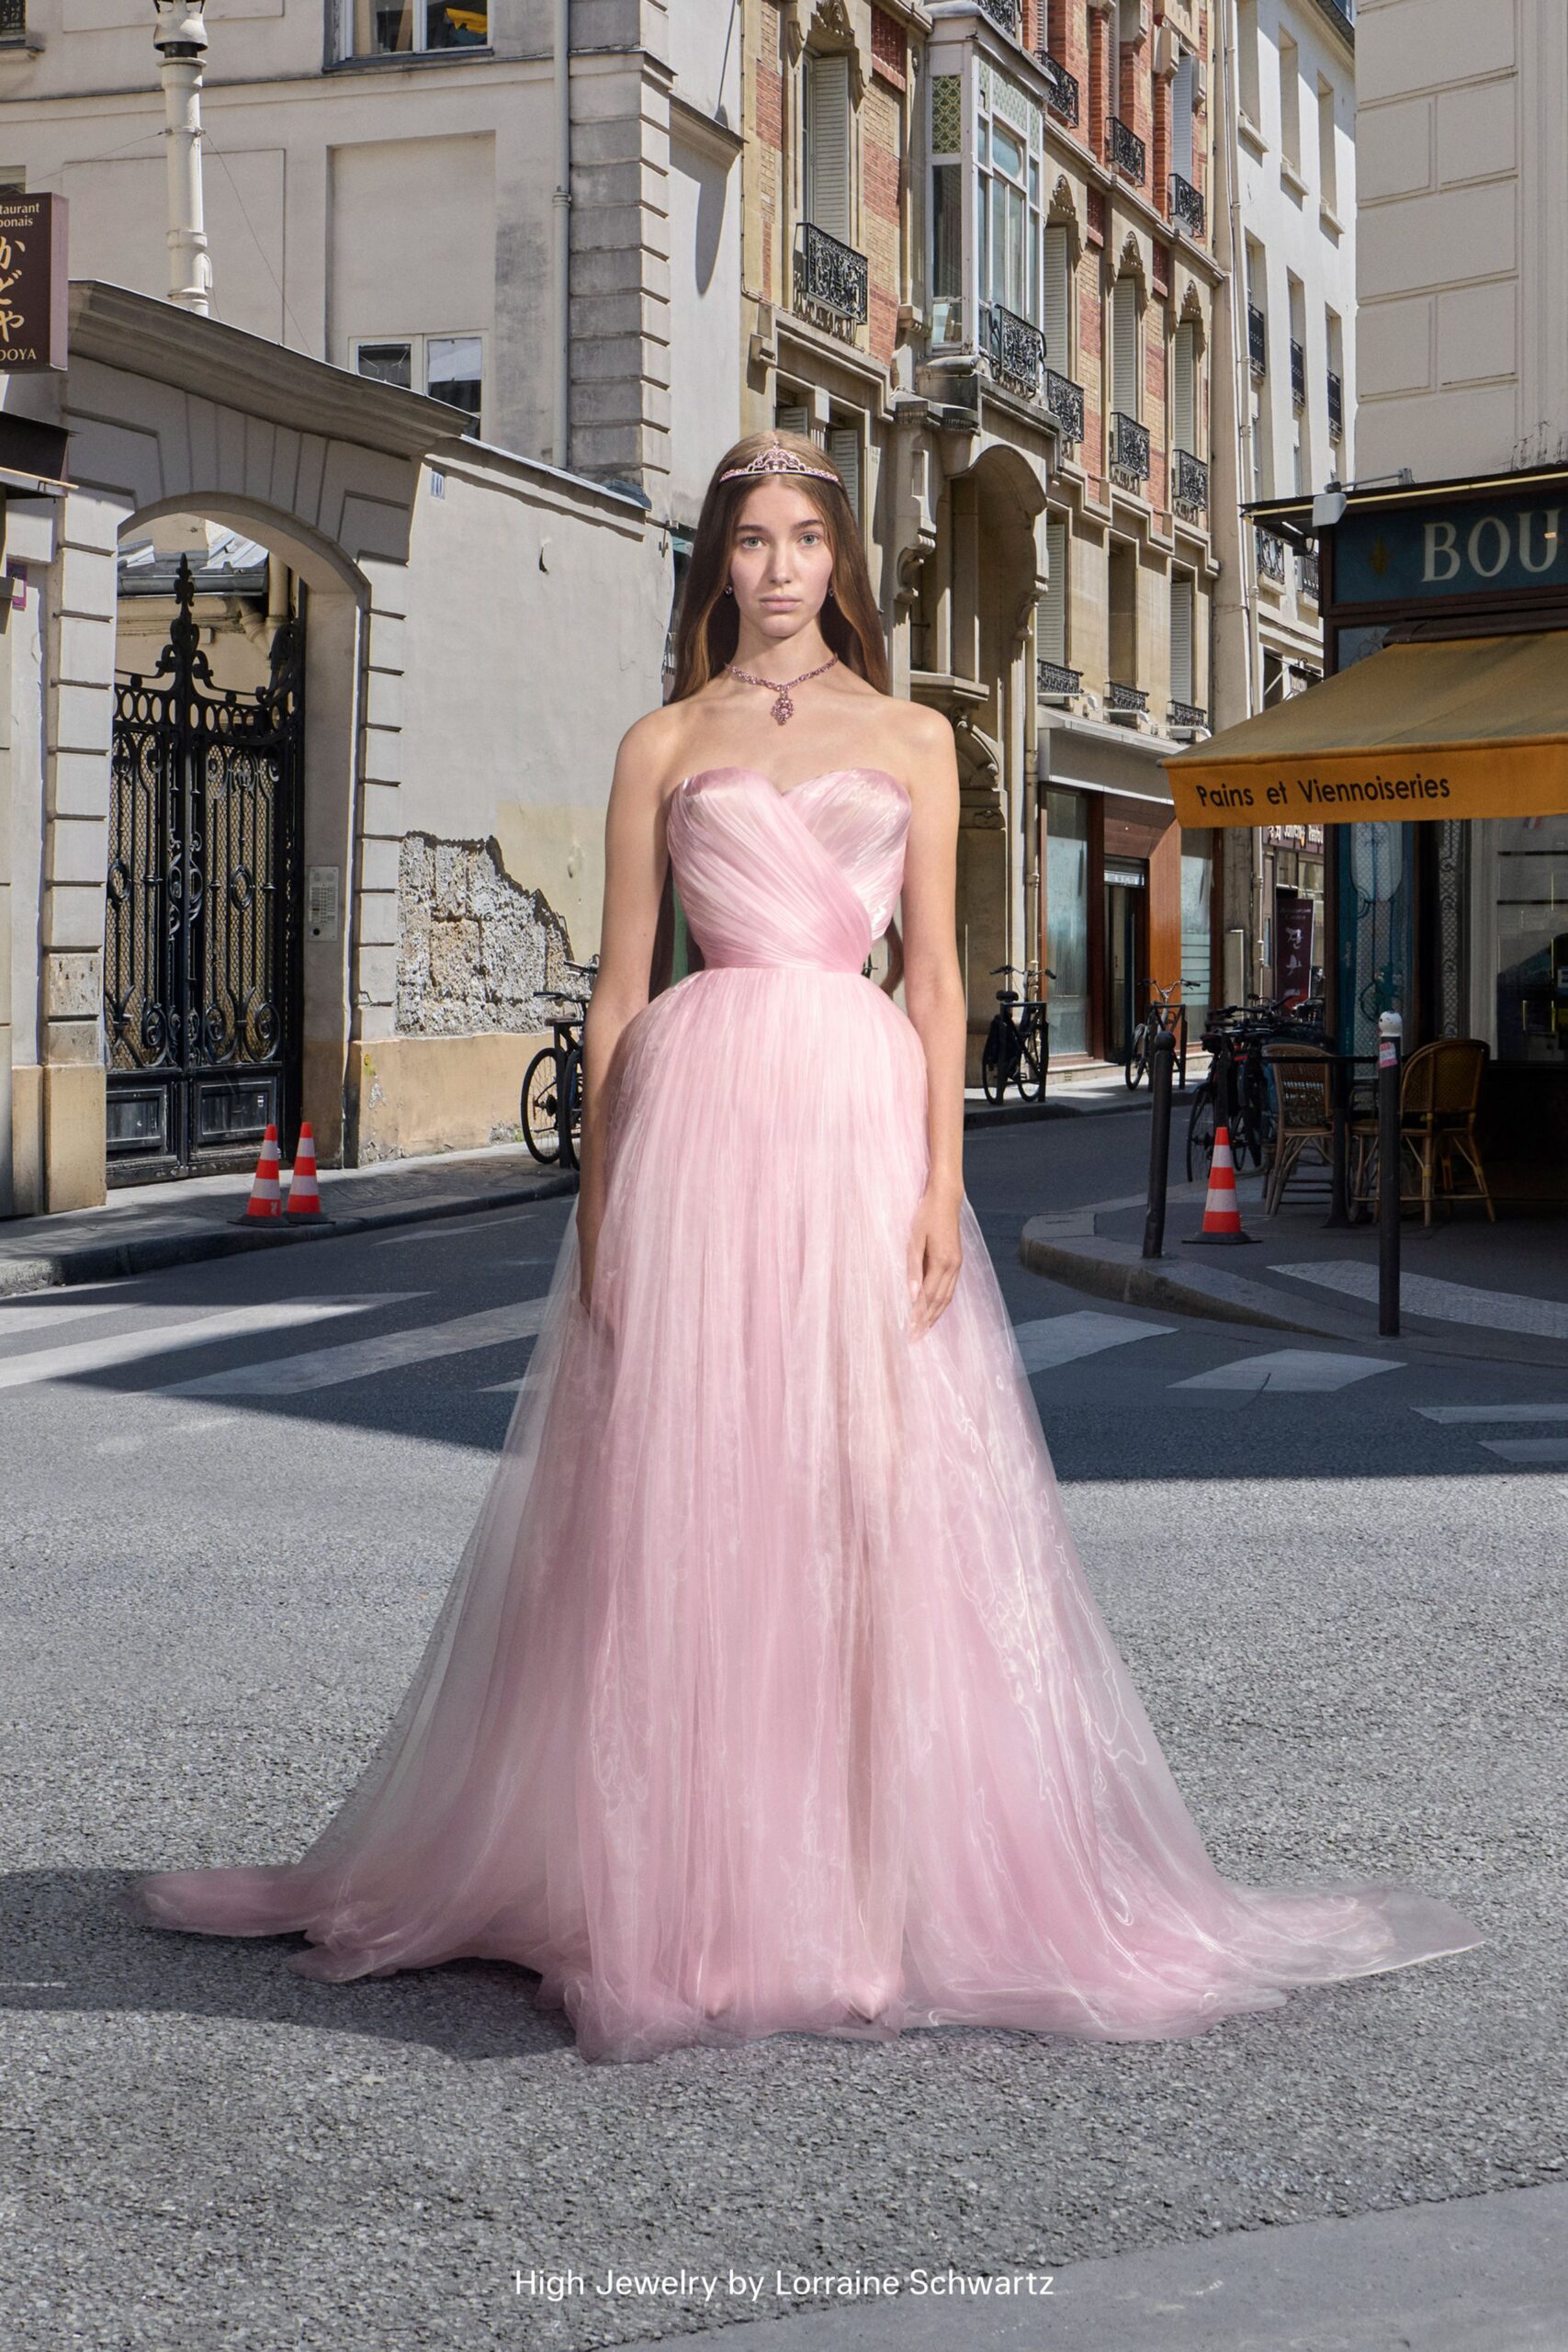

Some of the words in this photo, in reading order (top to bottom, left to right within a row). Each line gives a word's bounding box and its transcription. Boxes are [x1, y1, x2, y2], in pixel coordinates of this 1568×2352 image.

[0, 202, 40, 215] taurant
[1422, 509, 1561, 582] BOU
[1196, 783, 1254, 807] Pains
[1267, 780, 1288, 804] et
[1297, 773, 1450, 803] Viennoiseries
